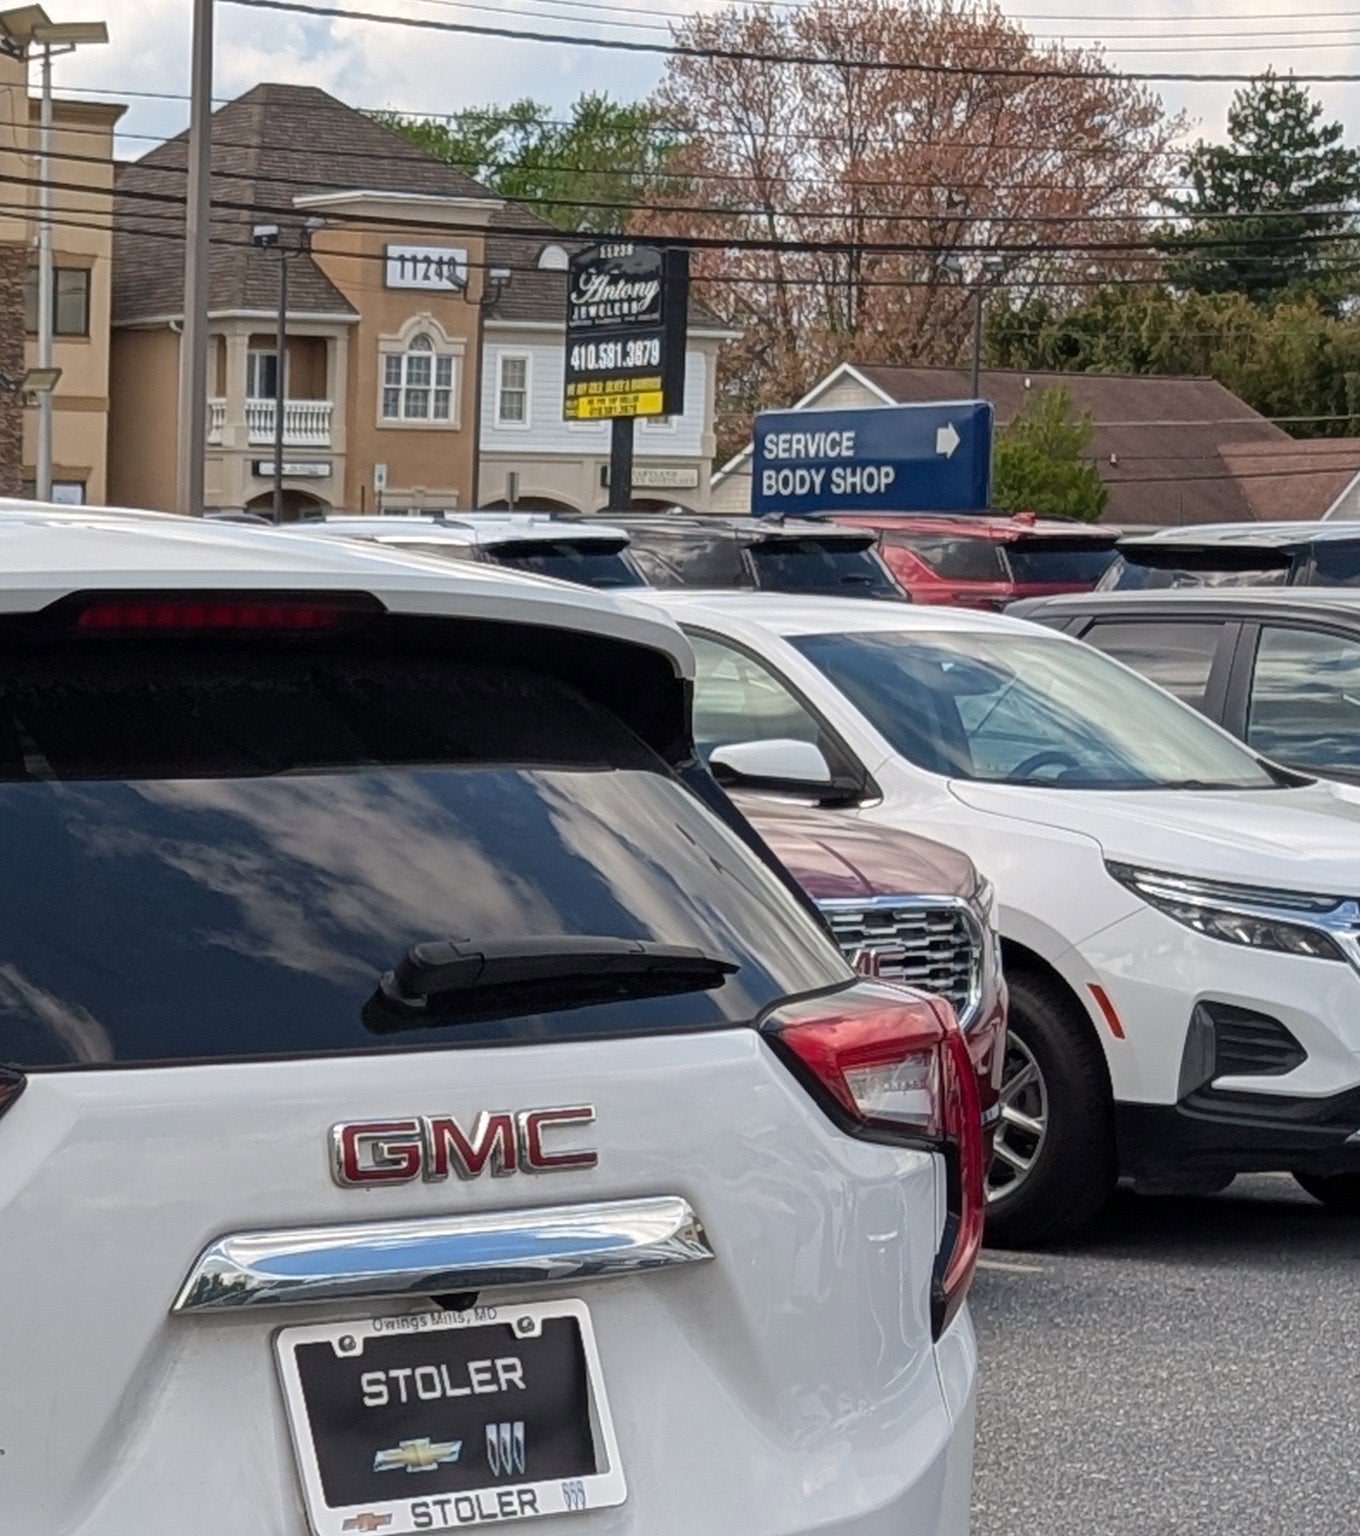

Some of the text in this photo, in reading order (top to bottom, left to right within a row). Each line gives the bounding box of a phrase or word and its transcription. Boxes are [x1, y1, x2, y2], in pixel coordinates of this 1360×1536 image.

[570, 267, 660, 311] Antony
[762, 431, 856, 460] SERVICE
[762, 465, 896, 496] BODY SHOP
[329, 1104, 599, 1190] GMC
[372, 1313, 428, 1332] Owings
[474, 1305, 498, 1321] MD
[360, 1356, 527, 1407] STOLER
[410, 1488, 541, 1528] STOLER
